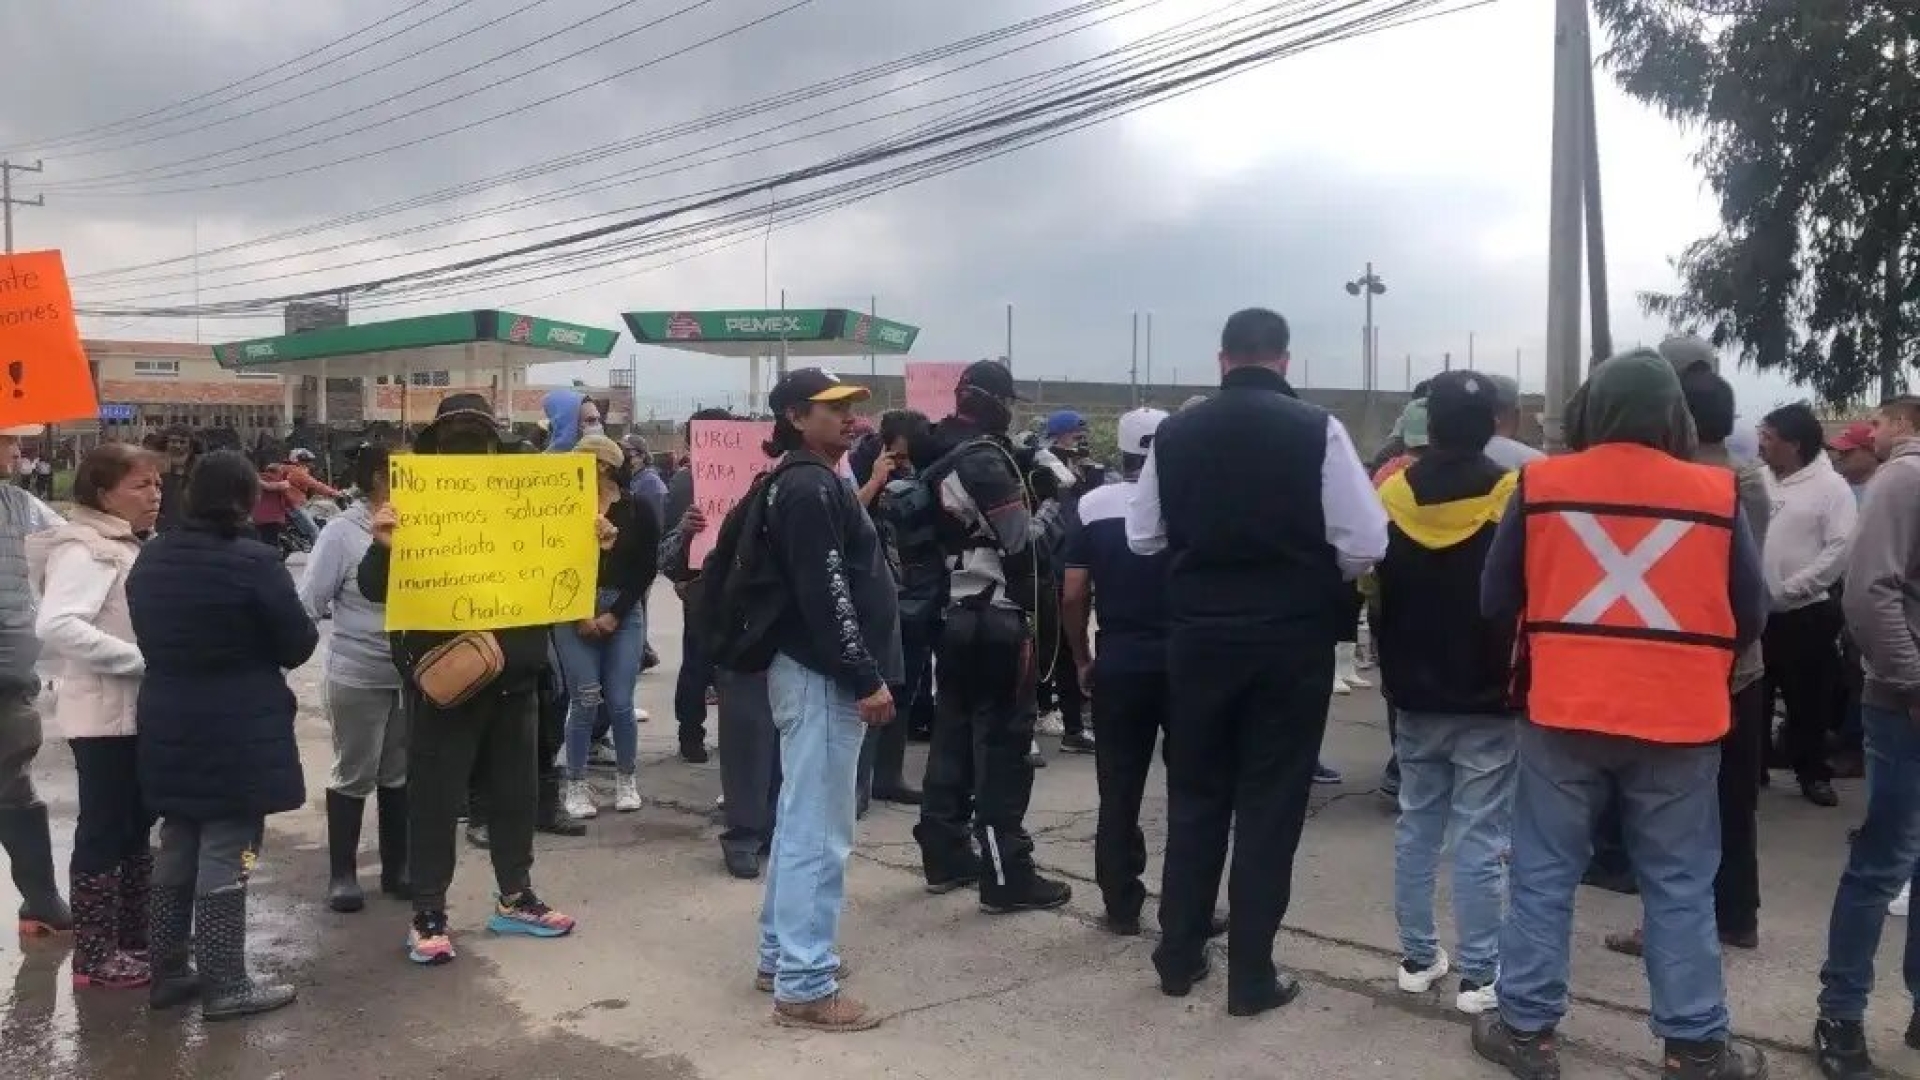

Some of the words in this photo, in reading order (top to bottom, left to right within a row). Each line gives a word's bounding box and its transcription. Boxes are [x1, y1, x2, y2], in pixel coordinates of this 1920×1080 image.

[725, 316, 801, 333] PEMEX
[400, 509, 488, 537] exigimos
[541, 523, 567, 549] las
[518, 565, 545, 580] en
[452, 594, 523, 622] Chalco
